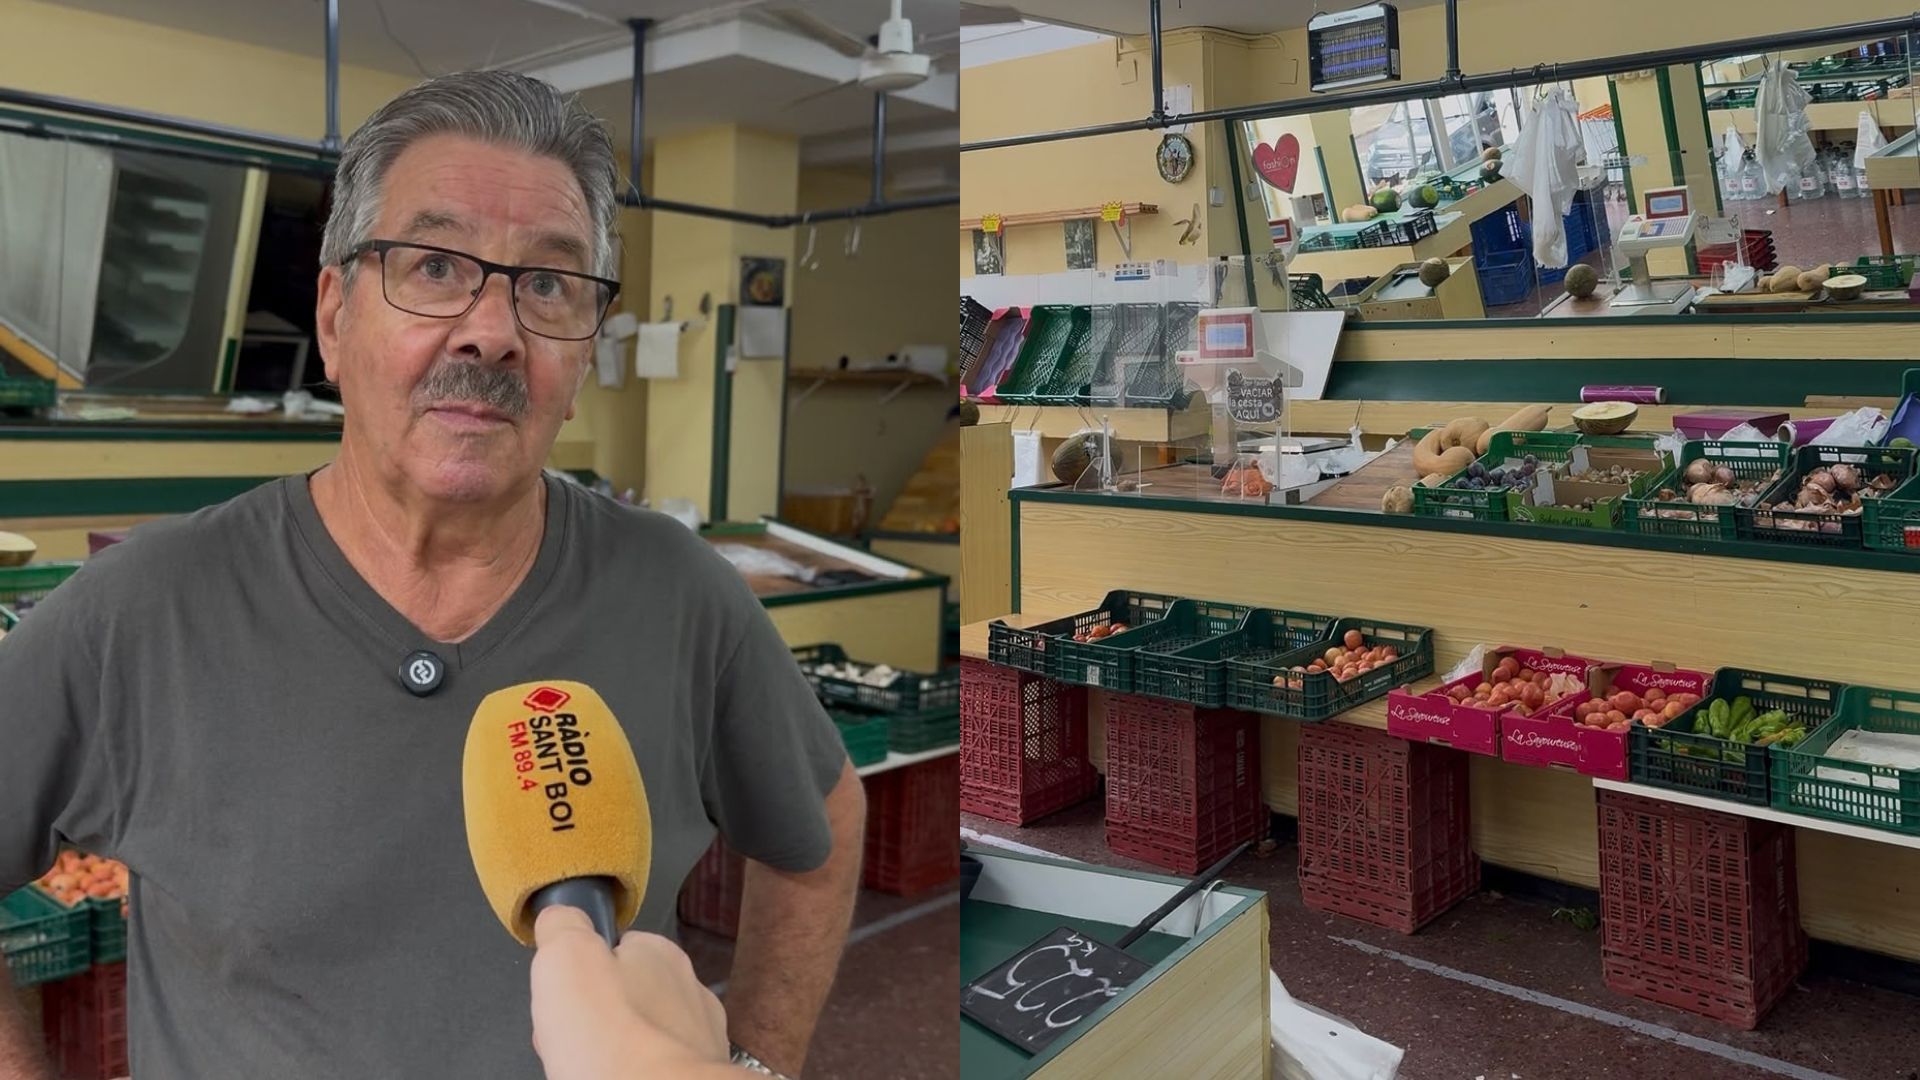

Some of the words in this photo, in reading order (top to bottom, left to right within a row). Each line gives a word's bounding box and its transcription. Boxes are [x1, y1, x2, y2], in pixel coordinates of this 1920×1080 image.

[1238, 398, 1263, 408] cesta
[1241, 388, 1273, 398] VACIAR
[508, 720, 530, 749] FM
[529, 715, 563, 773] SANT
[513, 749, 538, 791] 89.4
[545, 782, 575, 832] BOI
